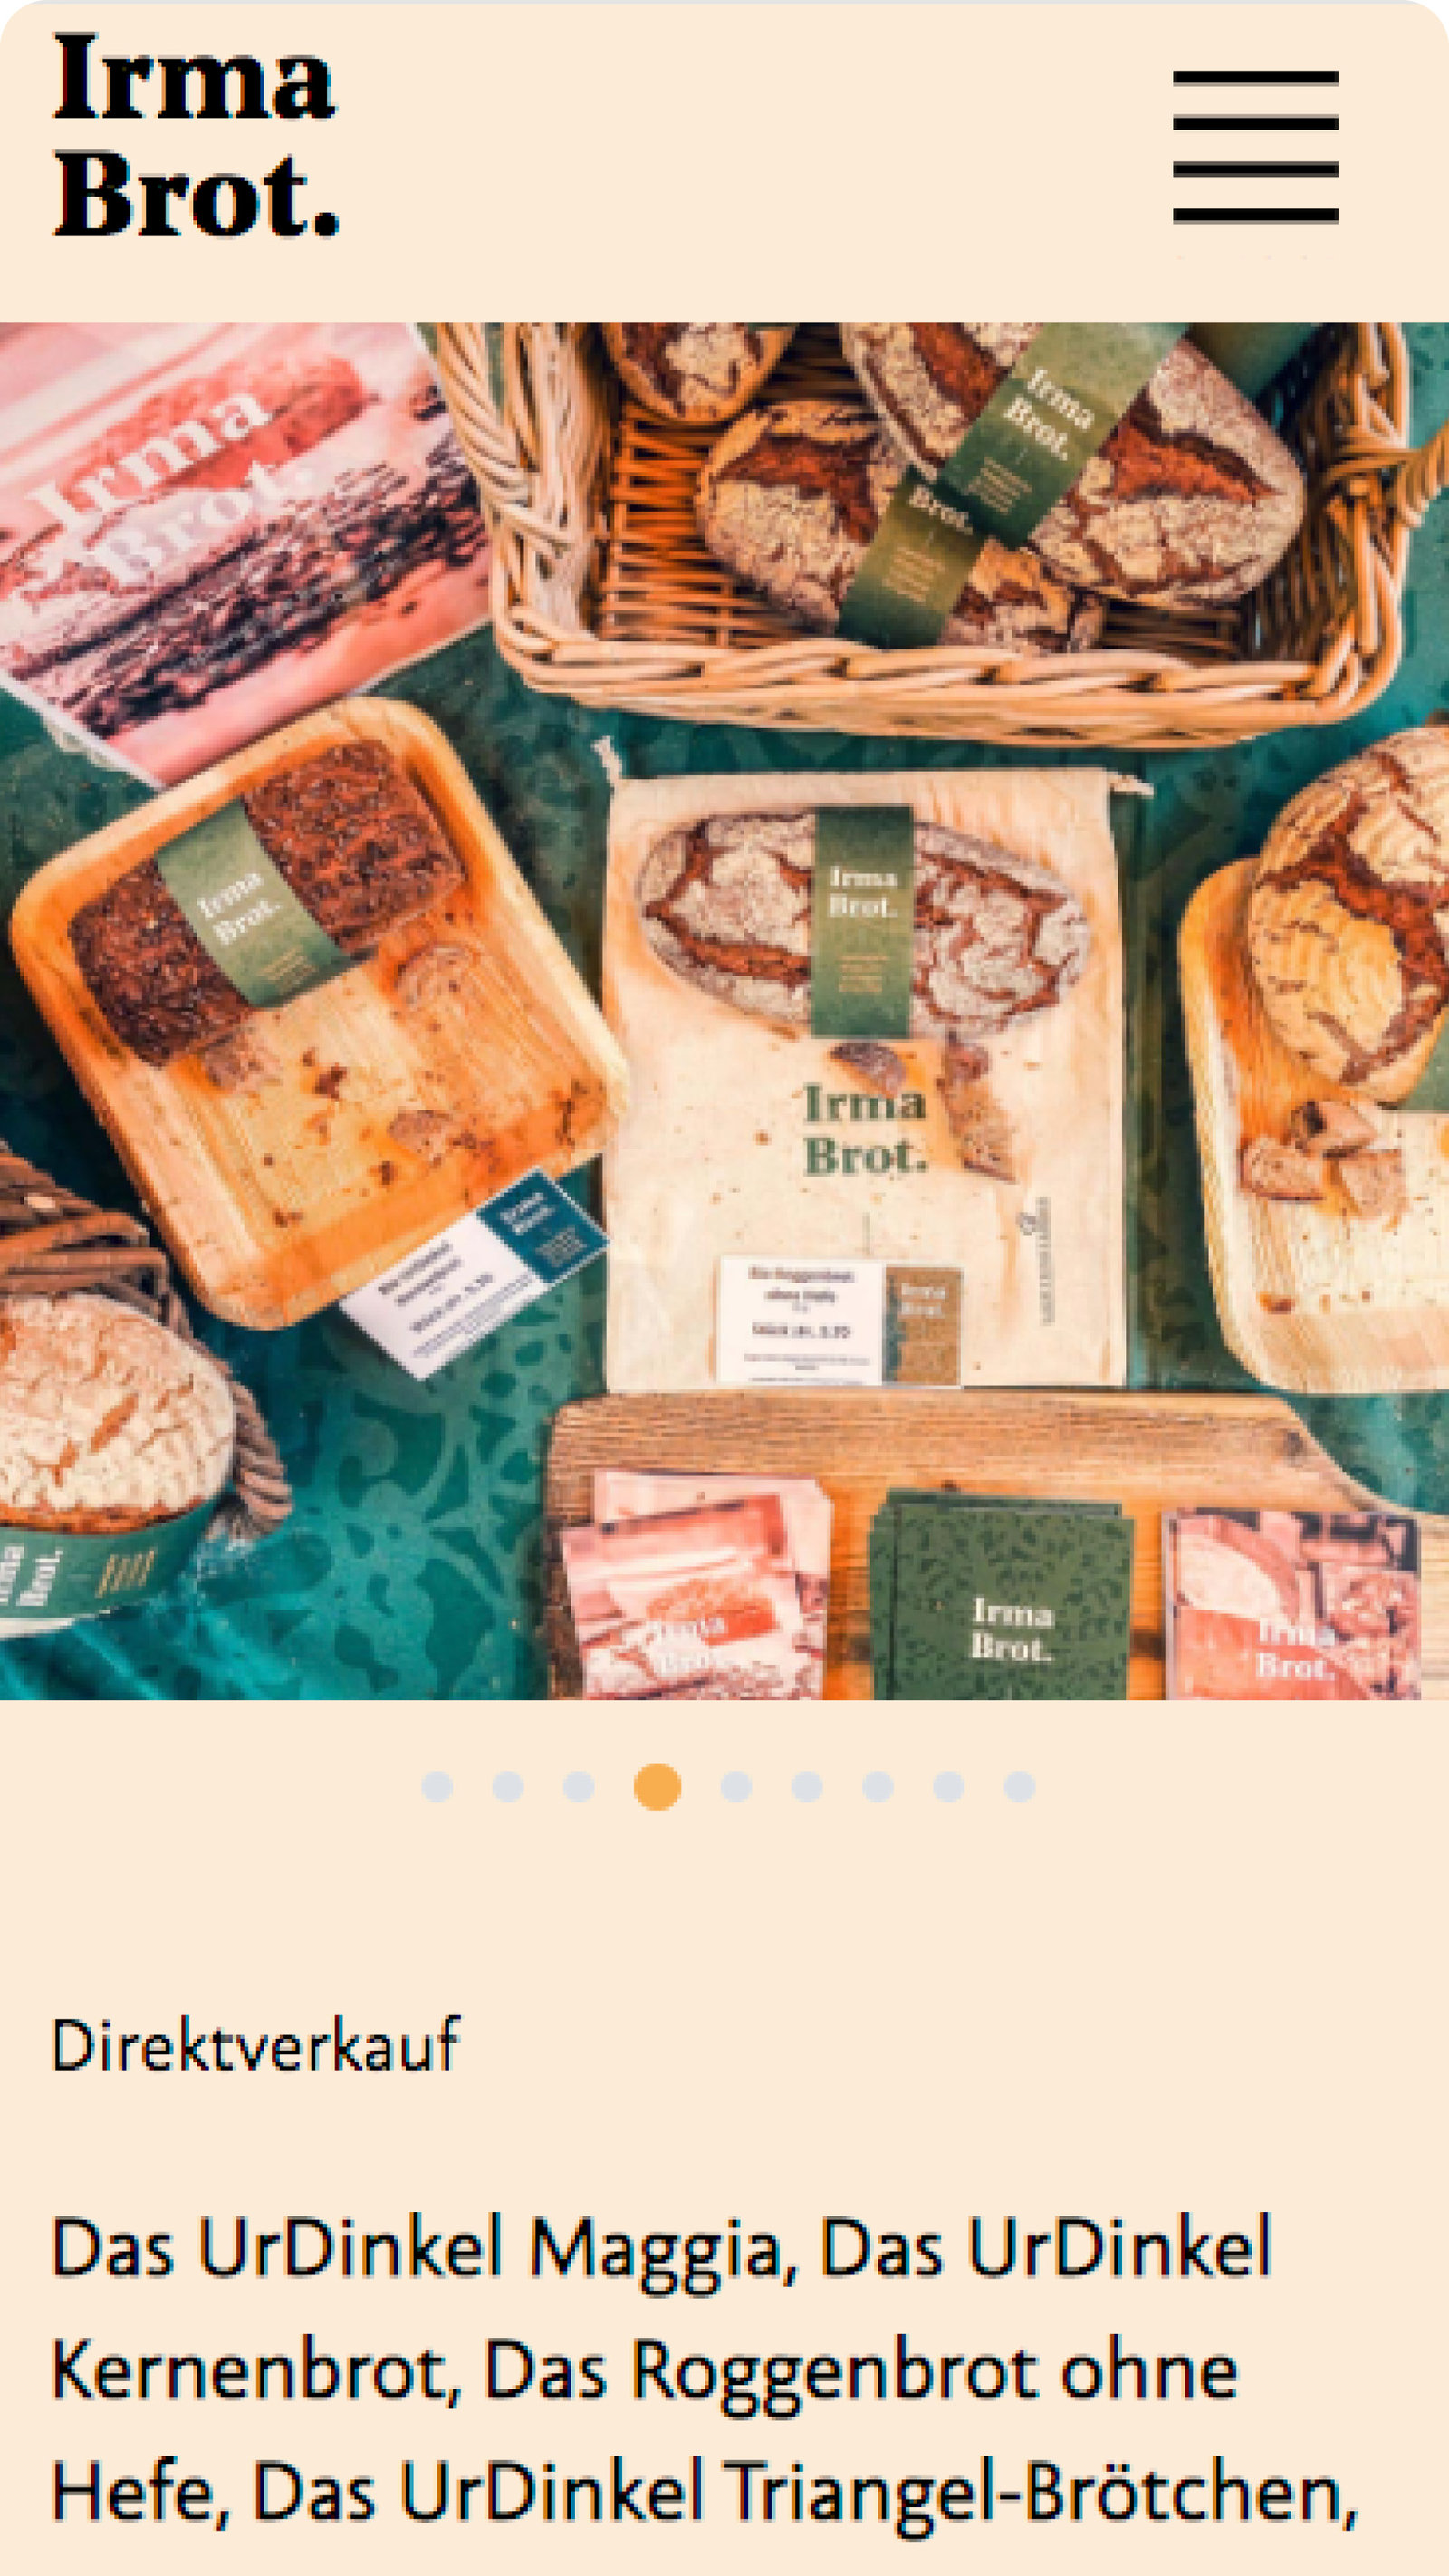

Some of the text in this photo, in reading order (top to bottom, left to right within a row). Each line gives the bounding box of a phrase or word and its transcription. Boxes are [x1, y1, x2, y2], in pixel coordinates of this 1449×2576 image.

[52, 32, 339, 120] Irma
[52, 149, 340, 237] Brot.
[1027, 368, 1095, 429] Irma
[1003, 395, 1068, 460] Brot.
[25, 395, 274, 530] Irma
[197, 873, 264, 921] Irma
[830, 865, 898, 887] Irma
[212, 899, 281, 945] Brot.
[829, 893, 898, 918] Brot.
[803, 1082, 927, 1123] Irma
[803, 1136, 930, 1177] Brot.
[973, 1597, 1055, 1629] Irma
[971, 1631, 1055, 1663] Brot.
[52, 2014, 461, 2071] Direktverkauf
[52, 2212, 1271, 2299] Das UrDinkel Maggia, Das UrDinkel
[52, 2333, 1238, 2421] Kernenbrot, Das Roggenbrot ohne
[52, 2456, 1358, 2543] Hefe, Das UrDinkel Triangel-Brötchen,
